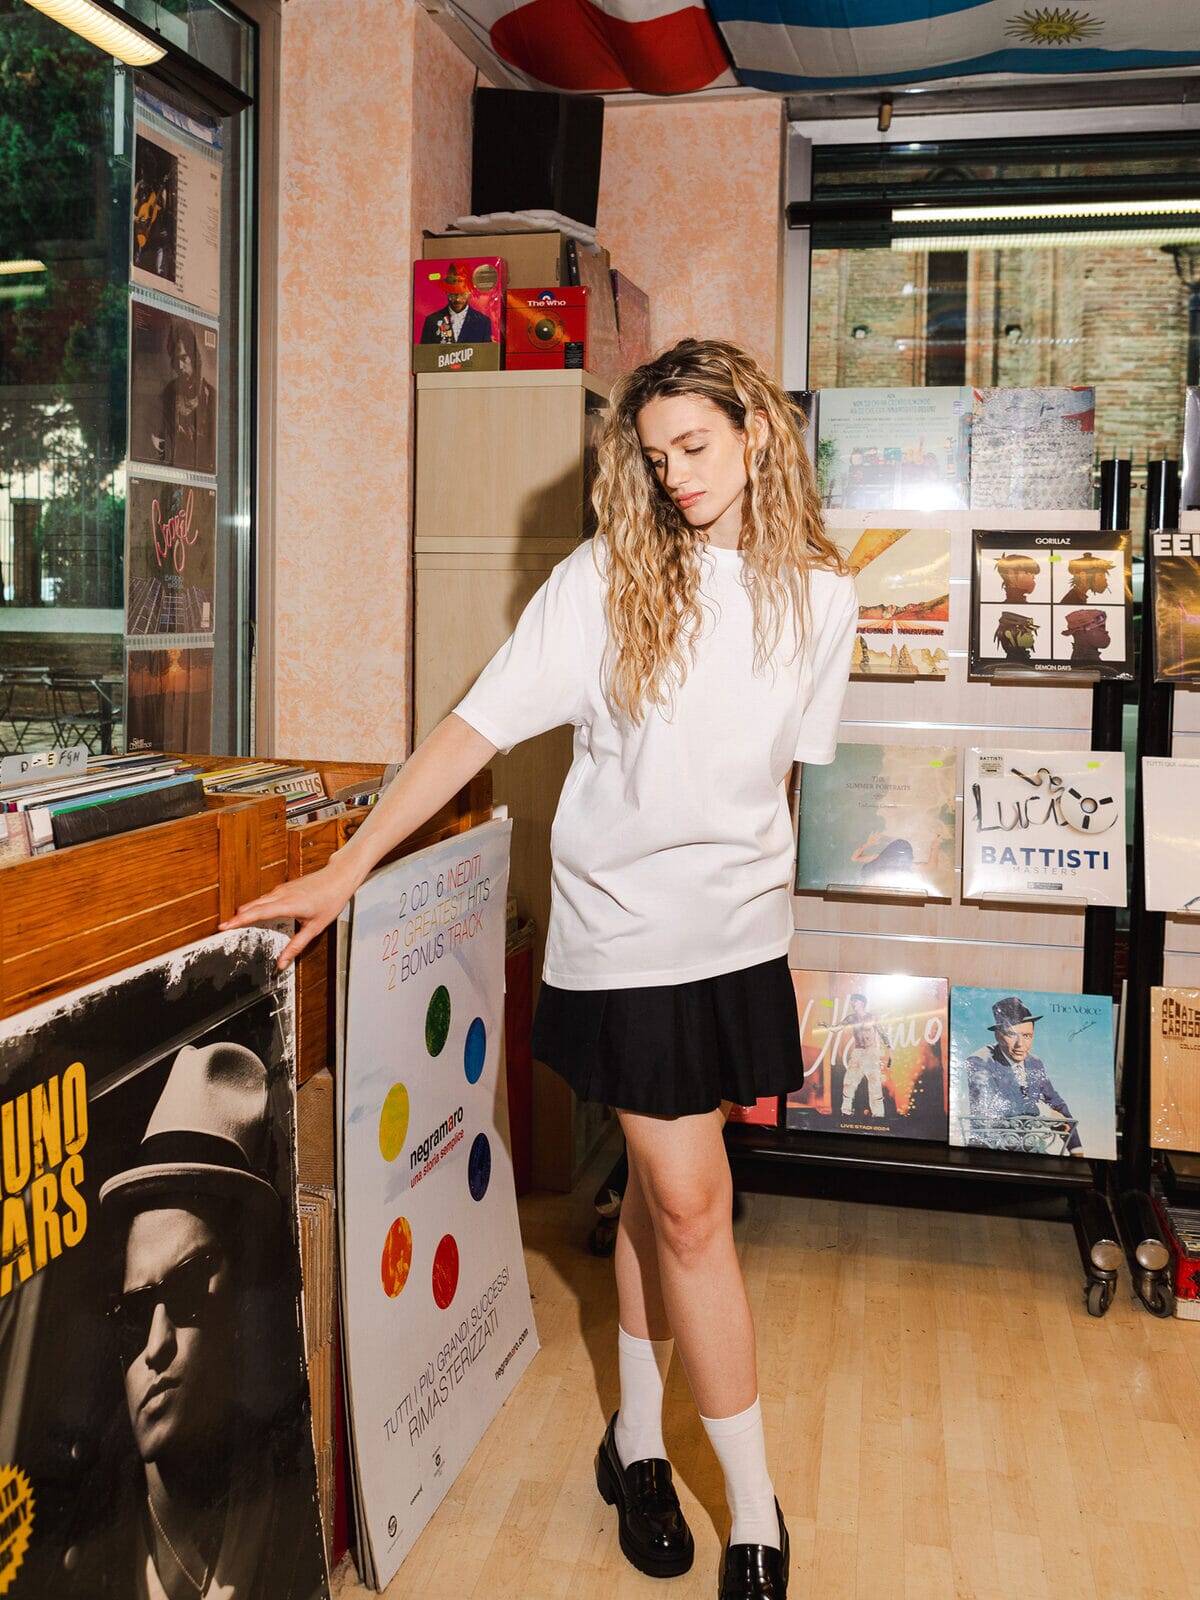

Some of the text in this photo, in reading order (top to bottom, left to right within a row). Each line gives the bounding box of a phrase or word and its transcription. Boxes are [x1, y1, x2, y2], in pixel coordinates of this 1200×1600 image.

[438, 348, 474, 368] BACKUP
[1035, 537, 1071, 545] GORILLAZ
[981, 846, 1109, 870] BATTISTI
[1012, 867, 1078, 876] MASTERS
[382, 878, 490, 961] 22 GREATEST HITS
[399, 892, 407, 919] 2
[411, 881, 429, 911] CD
[436, 874, 444, 898] 6
[388, 908, 483, 990] 2 BONUS TRACK
[1050, 1003, 1102, 1015] The Voice
[410, 1106, 464, 1170] negramaro
[410, 1129, 464, 1189] una storia semplice
[383, 1392, 413, 1441] TUTTI
[419, 1362, 435, 1396] PIÙ
[436, 1317, 470, 1372] GRANDI
[471, 1266, 510, 1327] SUCCESSI
[408, 1307, 499, 1447] RIMASTERIZZATI
[495, 1328, 529, 1380] negramaro.com
